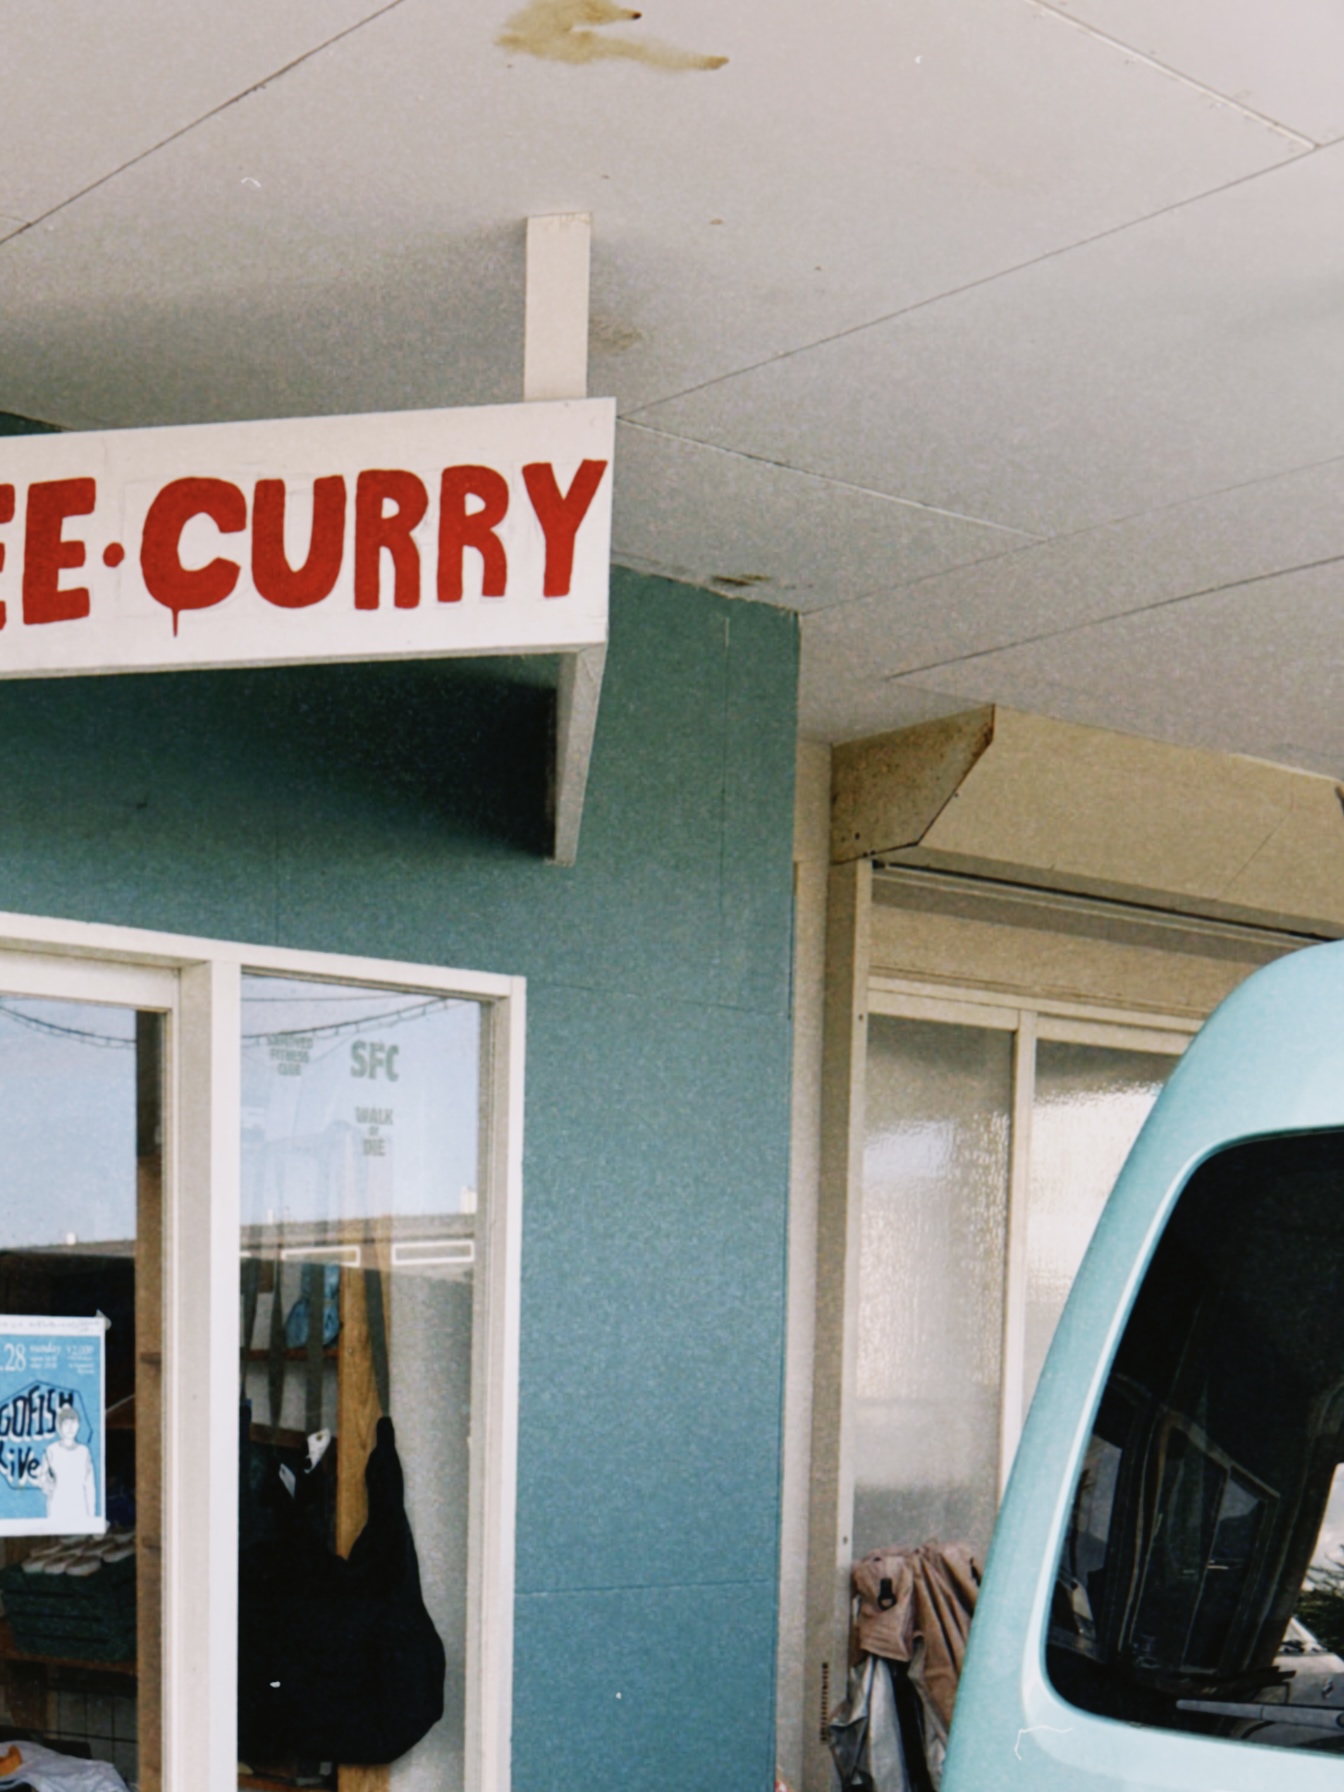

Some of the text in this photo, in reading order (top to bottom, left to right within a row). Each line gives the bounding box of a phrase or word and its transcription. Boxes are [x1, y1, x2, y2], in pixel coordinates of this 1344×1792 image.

[349, 1040, 400, 1083] SFC
[354, 1106, 394, 1125] WALK
[363, 1138, 386, 1156] DIE
